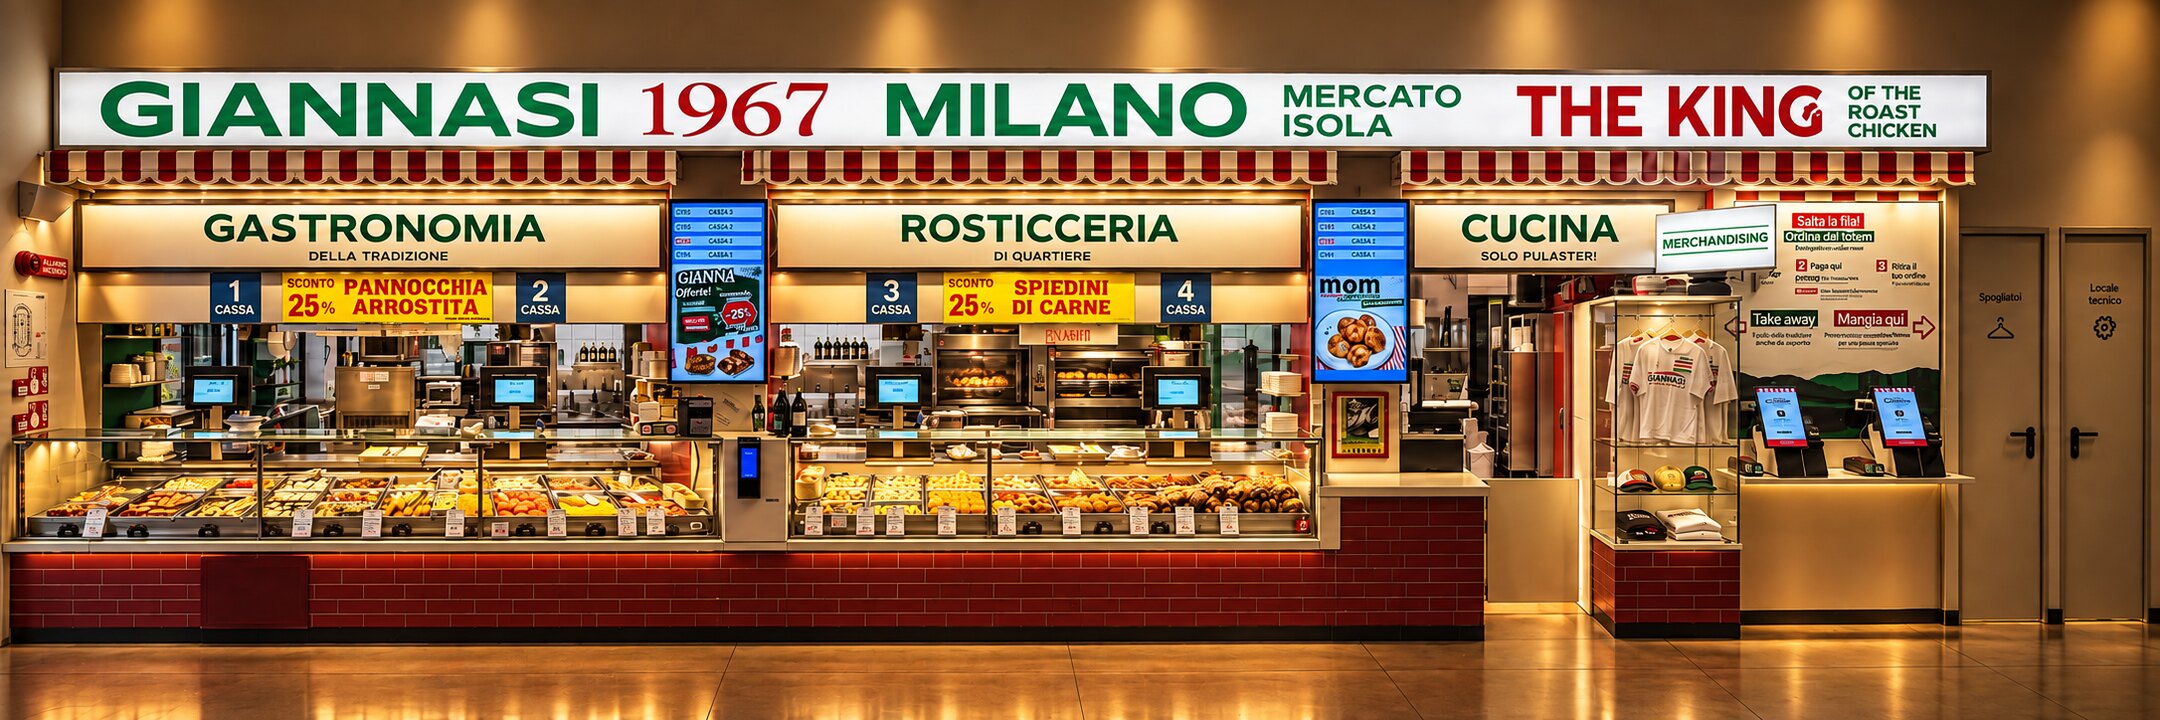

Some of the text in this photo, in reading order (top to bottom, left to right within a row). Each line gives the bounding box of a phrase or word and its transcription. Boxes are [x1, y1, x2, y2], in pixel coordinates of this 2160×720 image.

[1283, 84, 1462, 108] MERCATO
[1847, 85, 1922, 101] OF THE
[101, 81, 1248, 138] GIANNASI 1967 MILANO
[1516, 84, 1823, 138] THE KING
[1848, 104, 1922, 120] ROAST
[1283, 113, 1393, 138] ISOLA
[1847, 122, 1937, 138] CHICKEN
[203, 213, 546, 243] GASTRONOMIA
[901, 213, 1179, 243] ROSTICCERIA
[1461, 213, 1620, 243] CUCINA
[1797, 215, 1860, 227] Salta la fila!
[1662, 232, 1769, 250] MERCHANDISING
[1841, 231, 1873, 242] totem
[308, 251, 449, 262] DELLA TRADIZIONE
[994, 251, 1091, 263] DI QUARTIERE
[1481, 251, 1597, 262] SOLO PULASTER!
[1798, 260, 1842, 271] 2 Paga qui
[1878, 261, 1885, 271] 3
[287, 277, 335, 289] SCONTO
[344, 279, 488, 296] PANNOCCHIA
[532, 279, 549, 302] 2
[883, 279, 900, 302] 3
[948, 277, 994, 288] SCONTO
[1014, 279, 1109, 296] SPIEDINI
[1177, 279, 1195, 302] 4
[1320, 278, 1380, 293] mom
[2089, 283, 2119, 293] Locale
[228, 279, 240, 303] 1
[1979, 292, 2022, 304] Spogliatoi
[352, 298, 479, 315] ARROSTITA
[1012, 299, 1111, 316] DI CARNE
[2088, 296, 2122, 305] tecnico
[214, 304, 255, 315] CASSA
[520, 304, 561, 315] CASSA
[871, 304, 912, 315] CASSA
[1166, 304, 1206, 315] CASSA
[1752, 312, 1816, 329] Take away
[1838, 312, 1905, 329] Mangia qui
